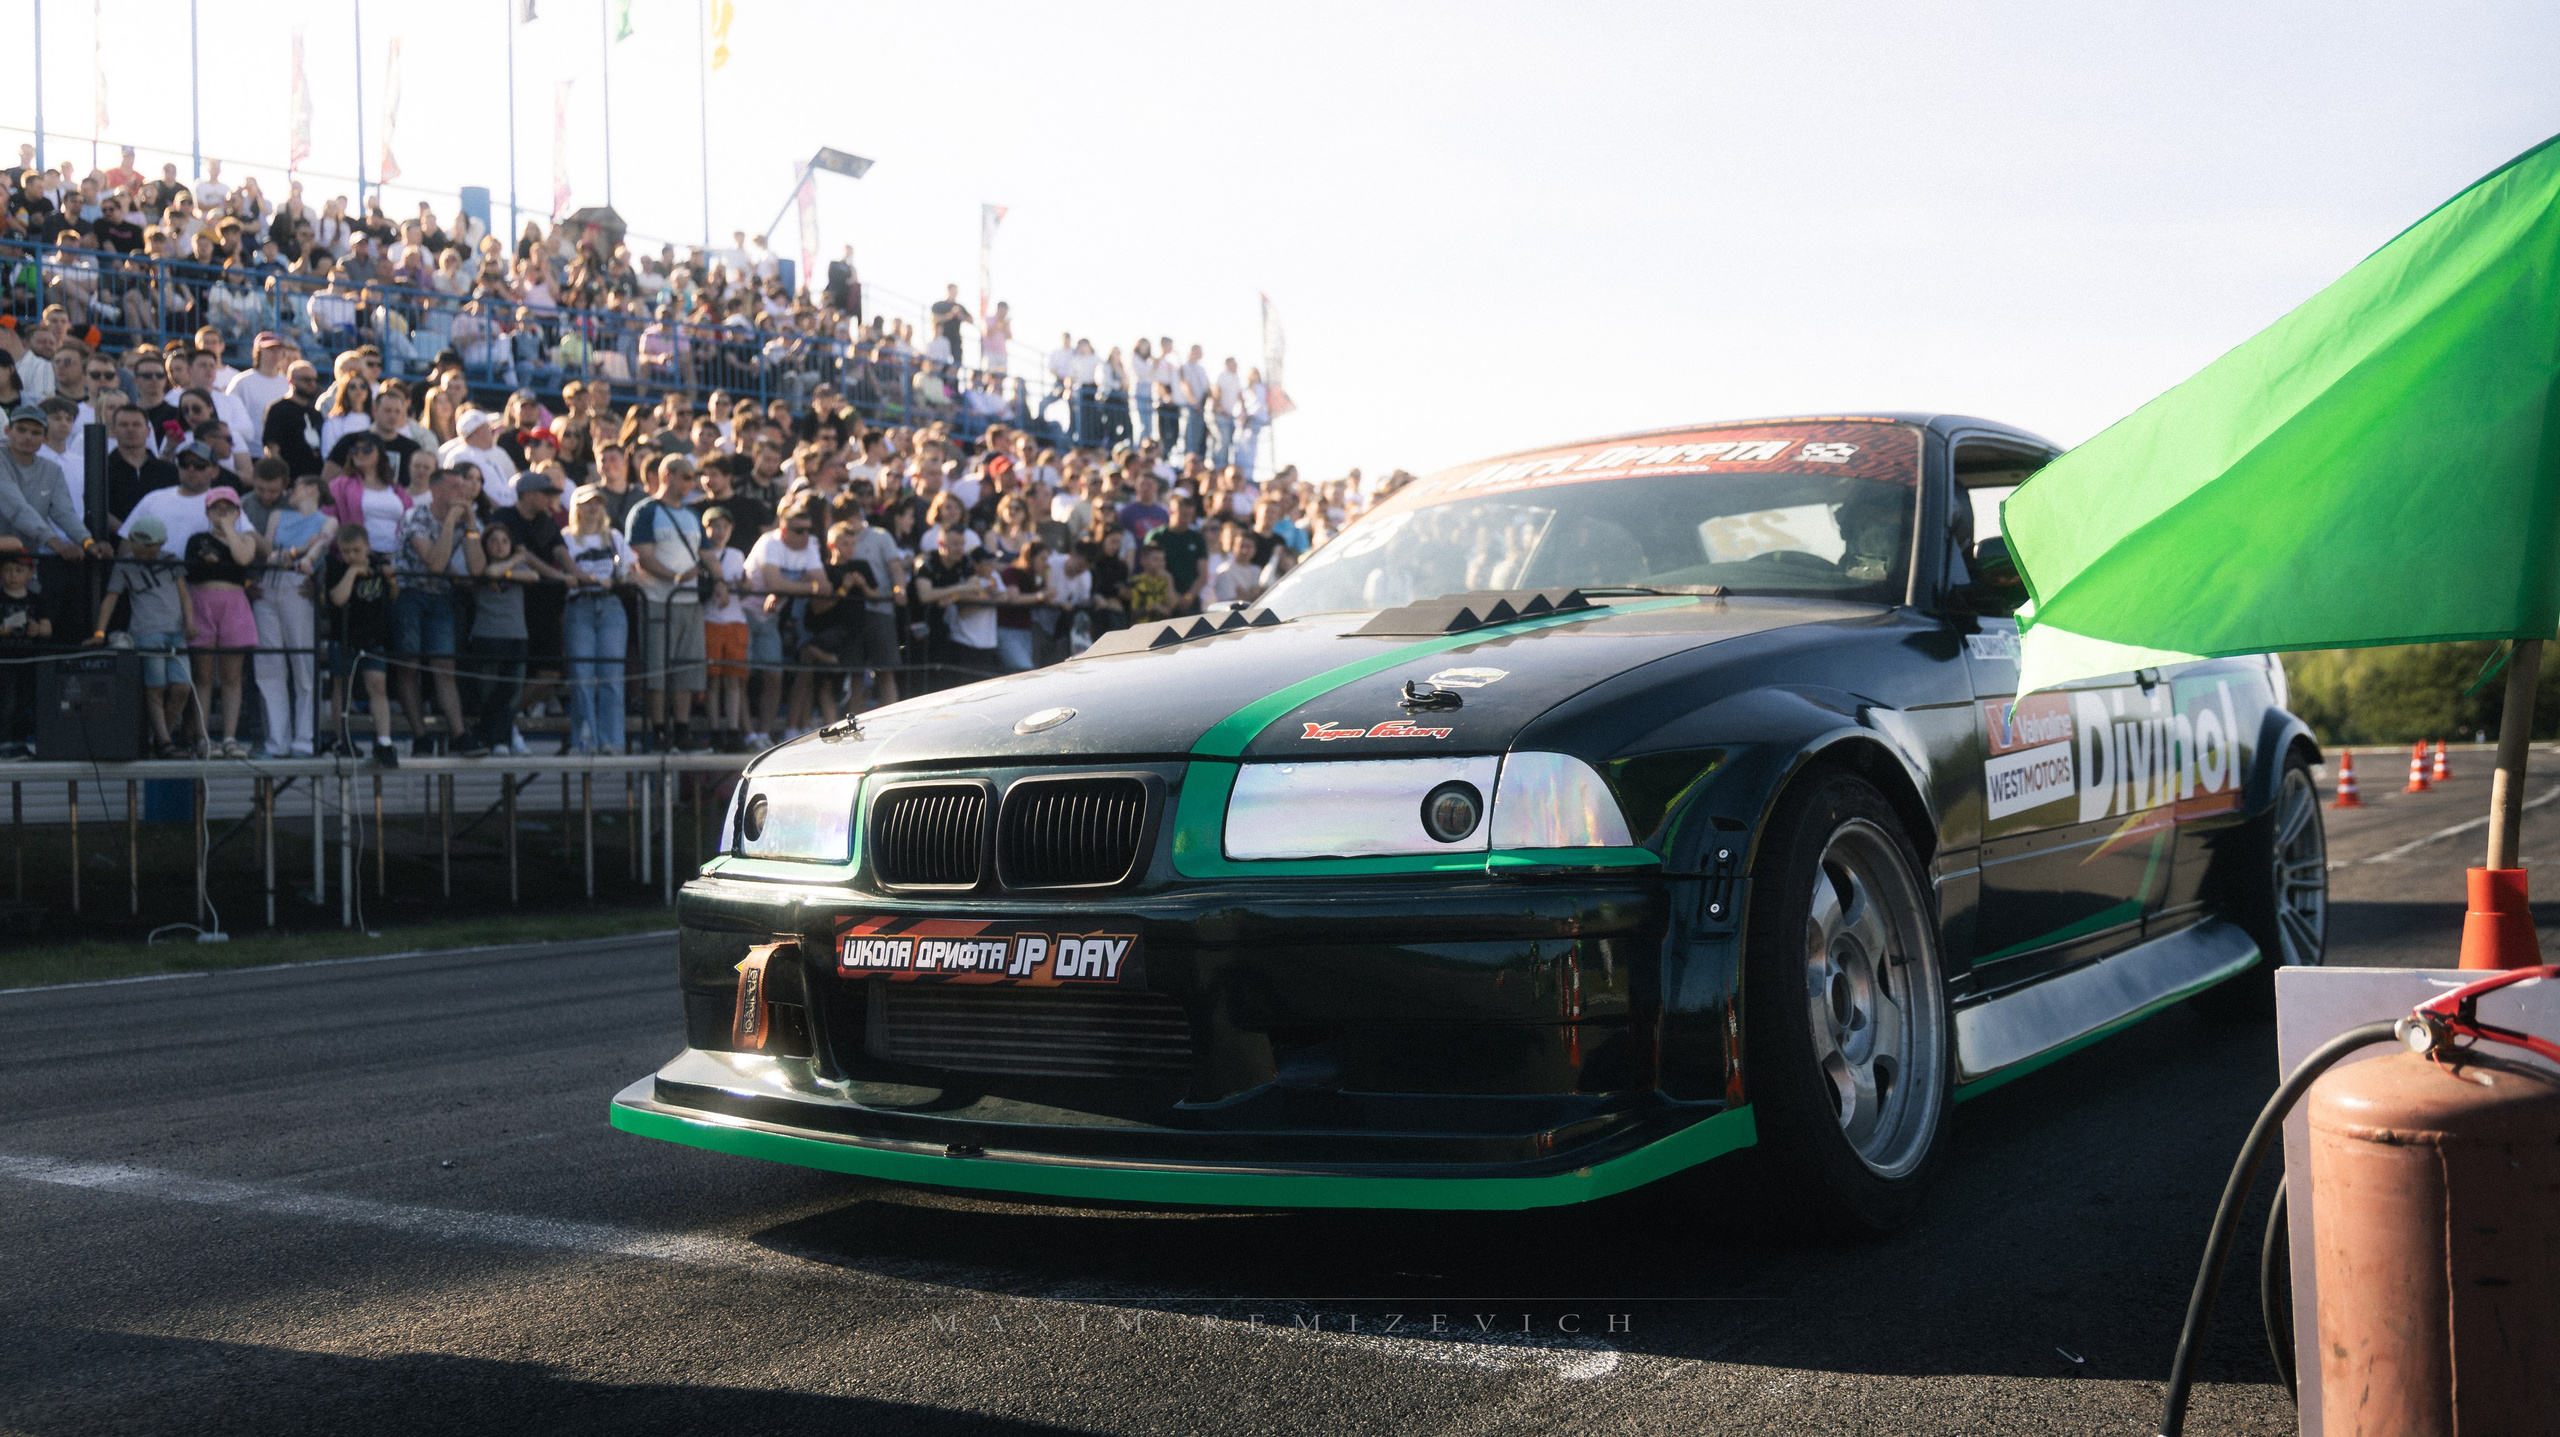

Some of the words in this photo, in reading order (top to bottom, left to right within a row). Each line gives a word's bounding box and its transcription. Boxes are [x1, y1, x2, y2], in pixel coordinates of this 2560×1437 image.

[1576, 439, 1793, 472] ДРИФТА
[1300, 721, 1365, 741] Yugen
[1365, 720, 1453, 739] Factory
[2016, 709, 2073, 745] Valvoline
[2076, 680, 2241, 823] Divinol
[1989, 755, 2071, 804] WESTMOTORS
[843, 939, 911, 968] ШКОЛА
[915, 940, 1007, 970] ДРИФТА
[1009, 938, 1048, 976] JP
[1055, 938, 1129, 977] DAY
